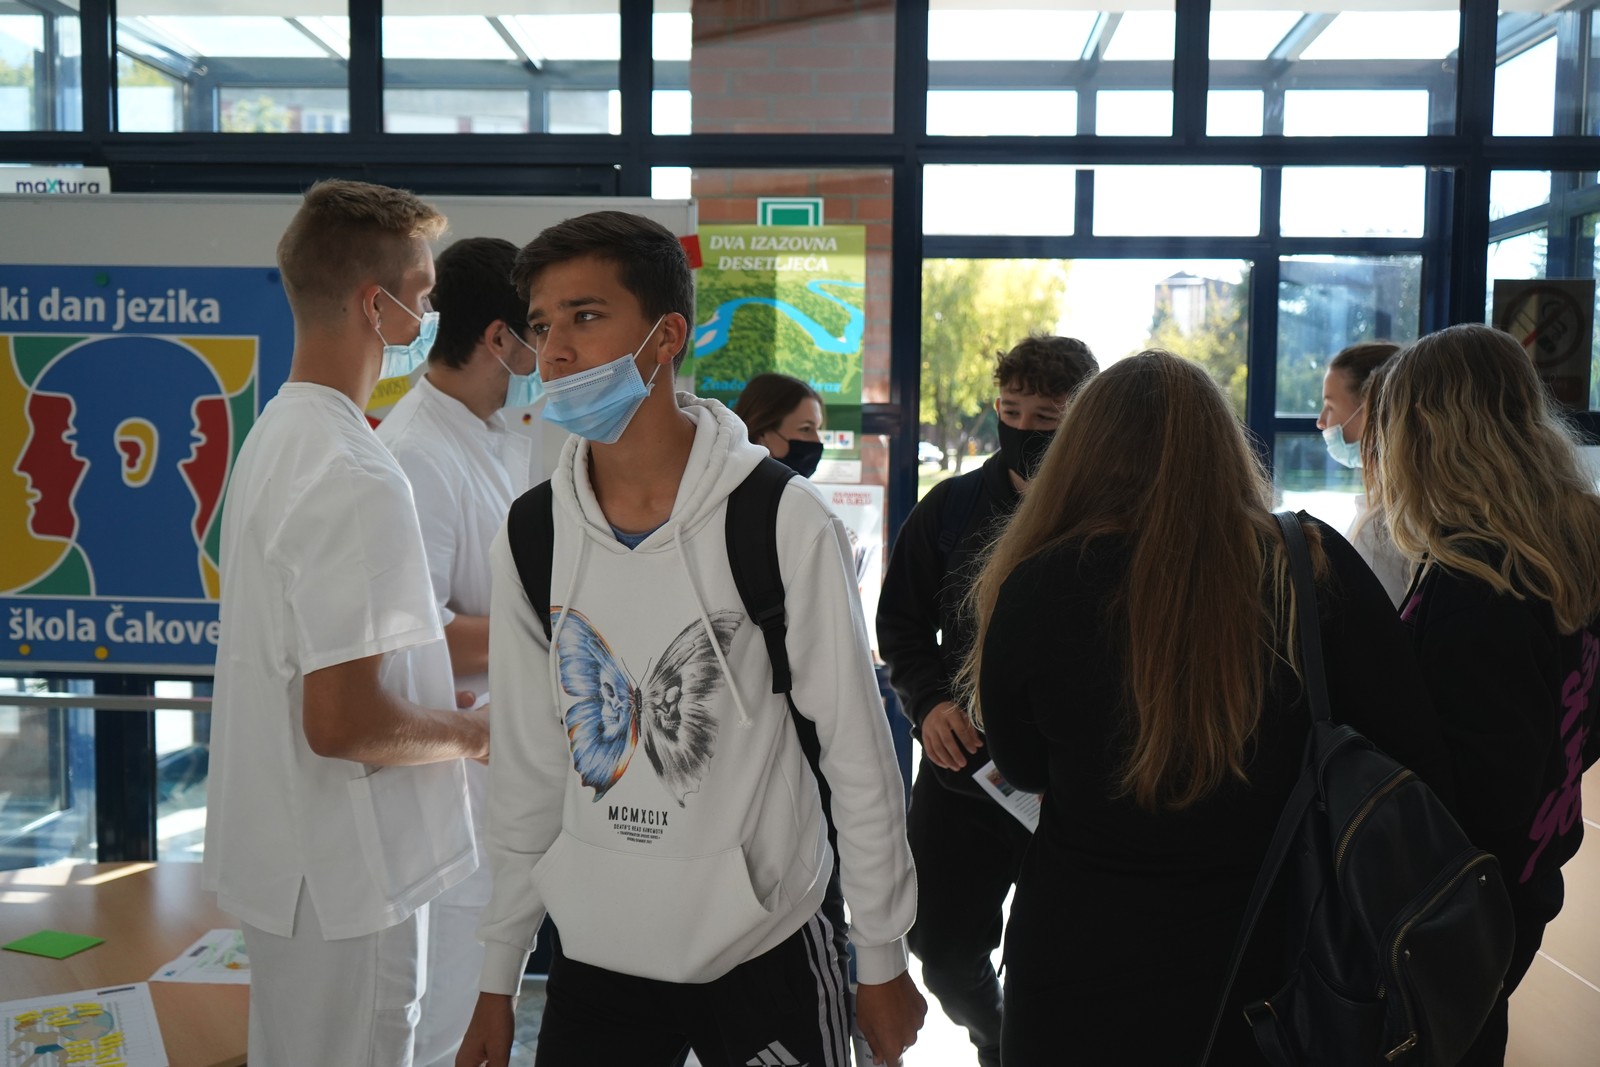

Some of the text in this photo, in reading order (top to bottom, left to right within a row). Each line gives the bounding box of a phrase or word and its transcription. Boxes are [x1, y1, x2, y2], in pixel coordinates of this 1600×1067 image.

[709, 235, 838, 251] DVA IZAZOVNA
[718, 254, 828, 272] DESETLJEĆA
[38, 287, 106, 322] dan
[112, 288, 220, 331] jezika
[9, 604, 220, 644] škola Čakove
[609, 806, 668, 826] MCMXCIX
